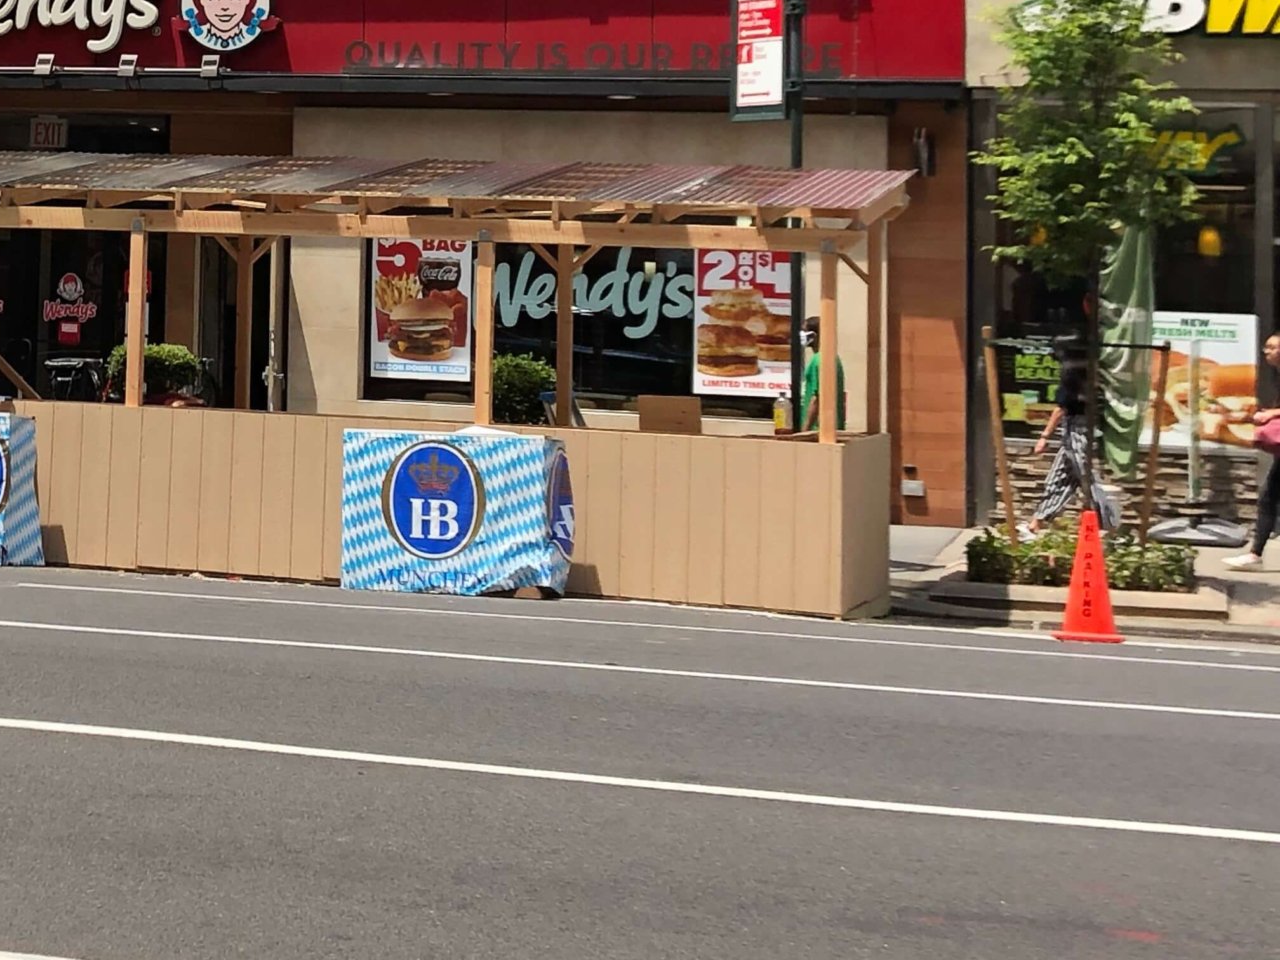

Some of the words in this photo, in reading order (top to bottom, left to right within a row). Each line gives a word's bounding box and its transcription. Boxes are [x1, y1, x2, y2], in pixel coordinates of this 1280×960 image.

[344, 40, 524, 70] QUALITY
[535, 41, 569, 70] IS
[583, 41, 674, 71] OUR
[691, 41, 843, 73] REPE
[34, 121, 64, 147] EXIT
[422, 239, 467, 253] BAG
[702, 250, 737, 290] 2
[738, 251, 755, 290] FOR
[43, 297, 98, 324] Wendy's
[1180, 319, 1210, 328] NEW
[702, 380, 740, 388] LIMITED
[742, 381, 766, 389] TIME
[409, 498, 459, 540] HB
